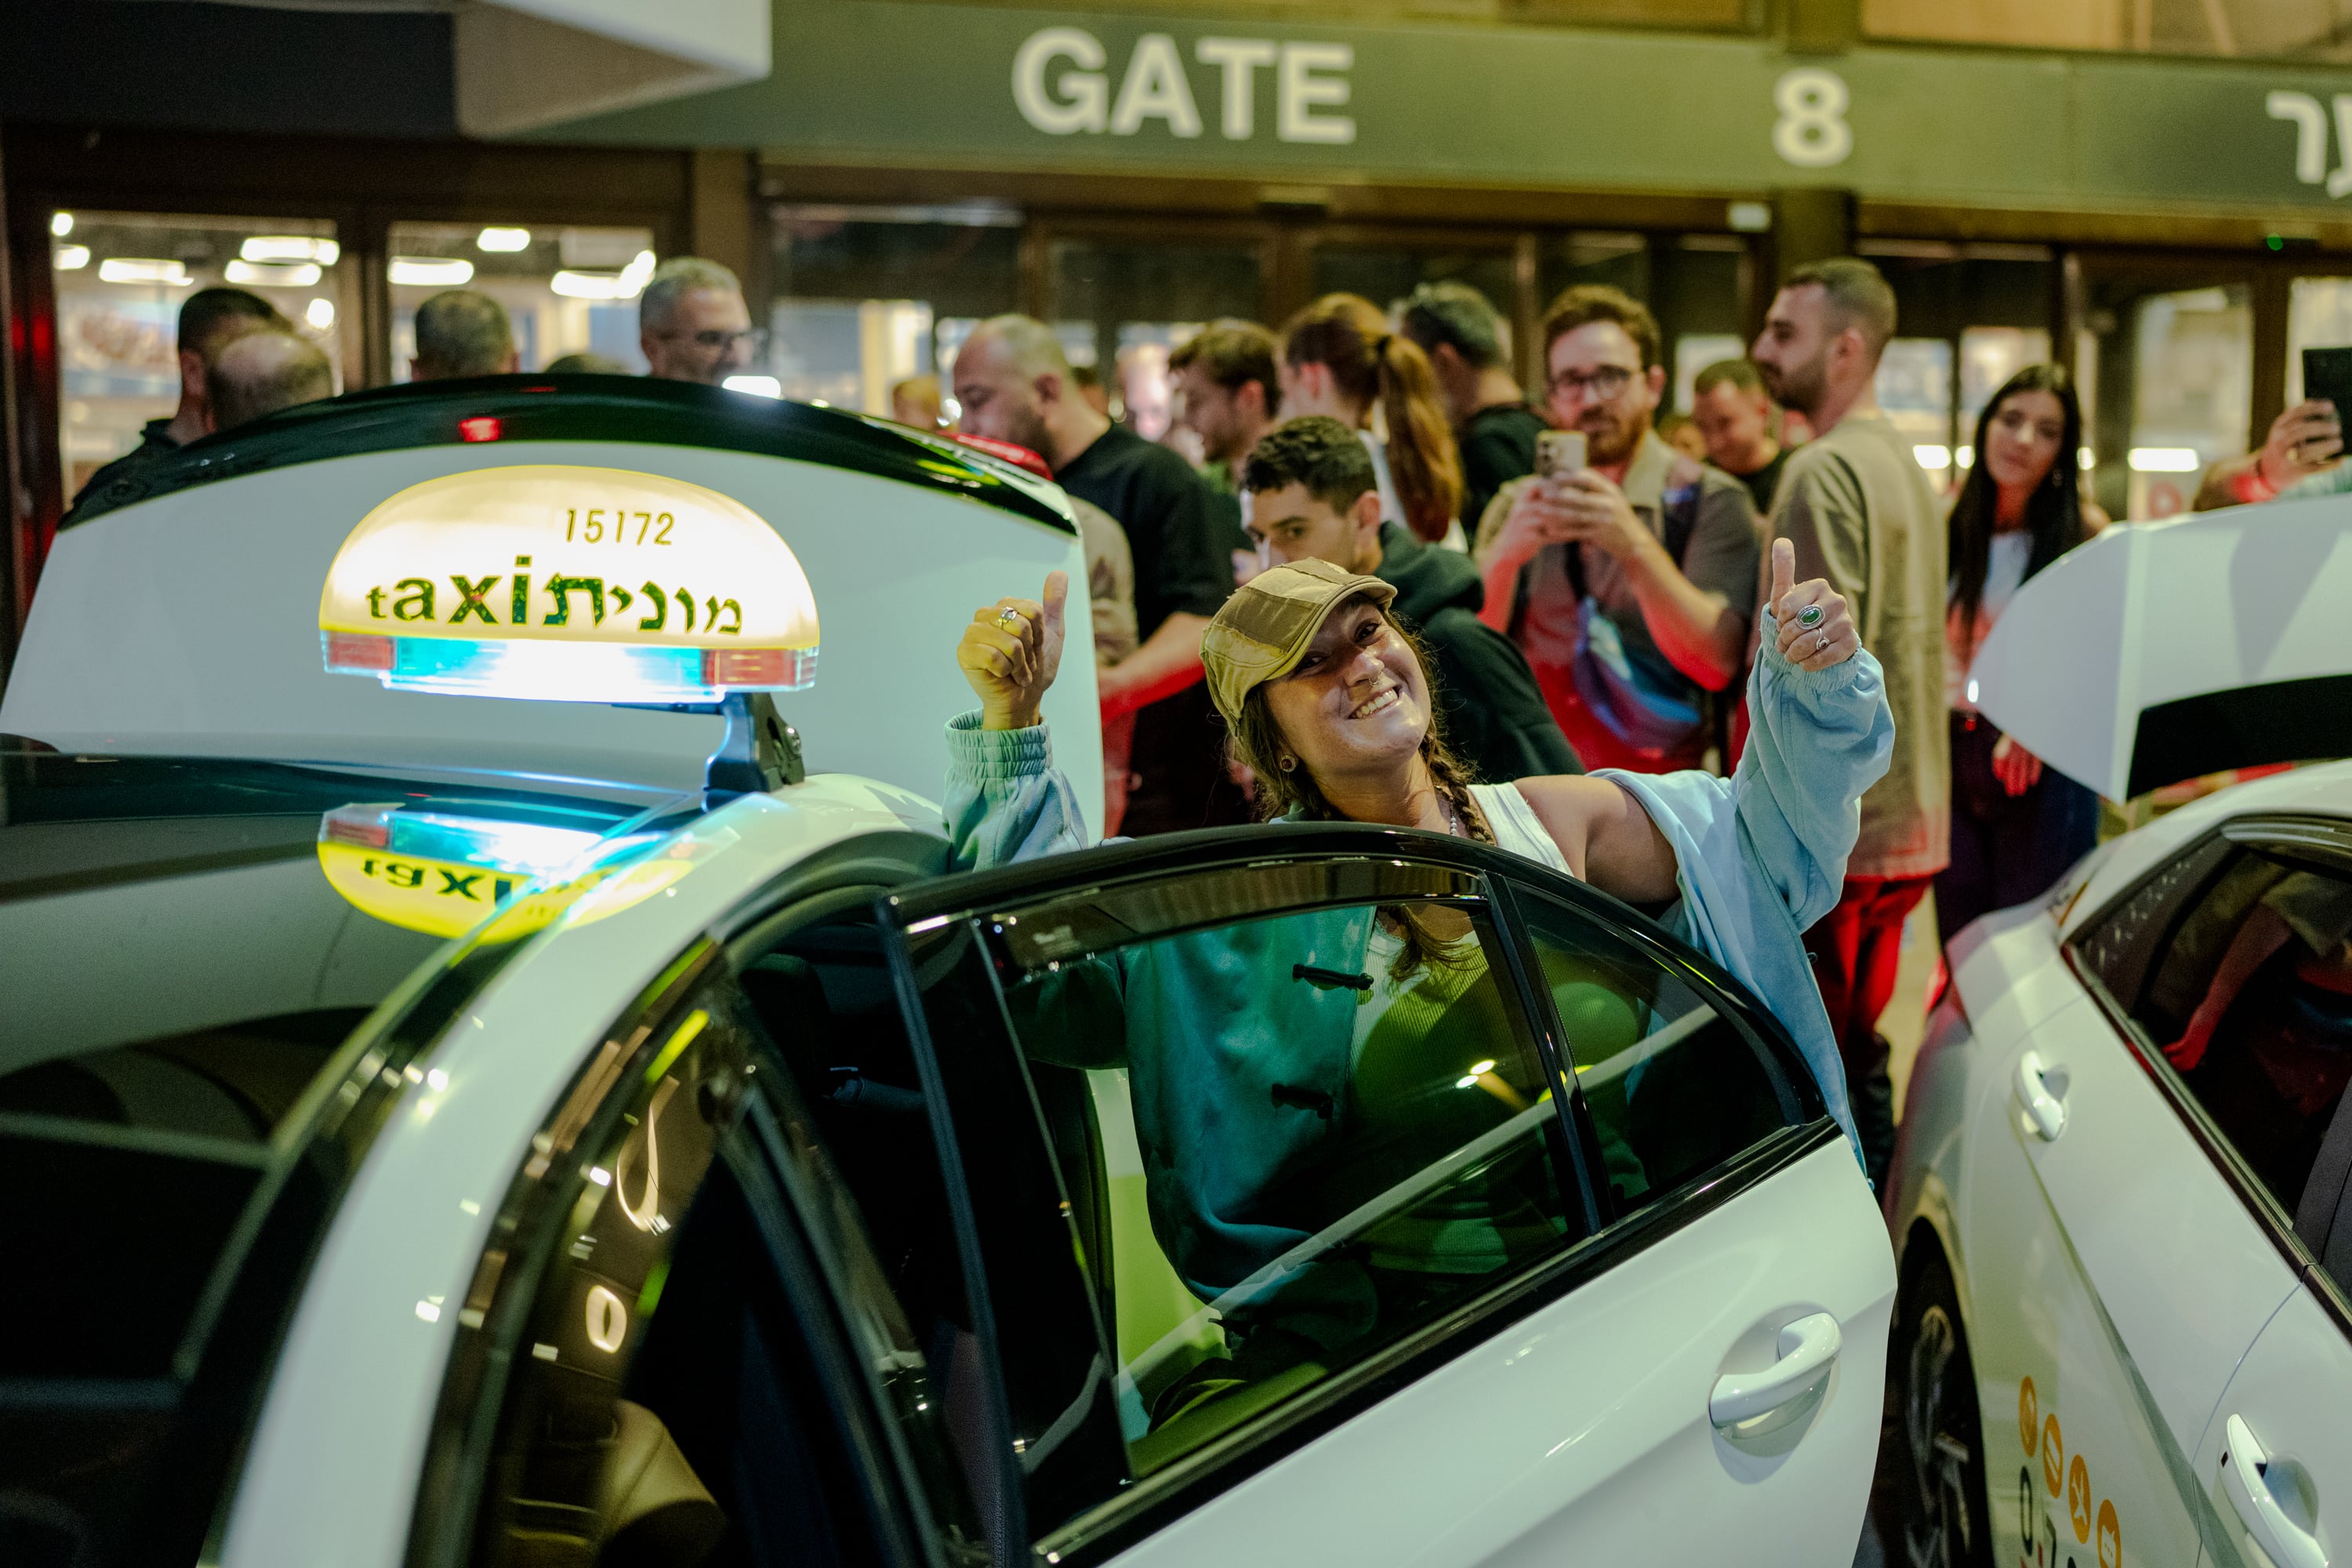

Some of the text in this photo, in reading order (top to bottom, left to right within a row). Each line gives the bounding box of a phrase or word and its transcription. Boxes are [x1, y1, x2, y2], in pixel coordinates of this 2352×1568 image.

[1011, 27, 1853, 168] GATE 8
[565, 507, 676, 546] 15172
[366, 554, 534, 626] taxi
[542, 572, 744, 635] מונית
